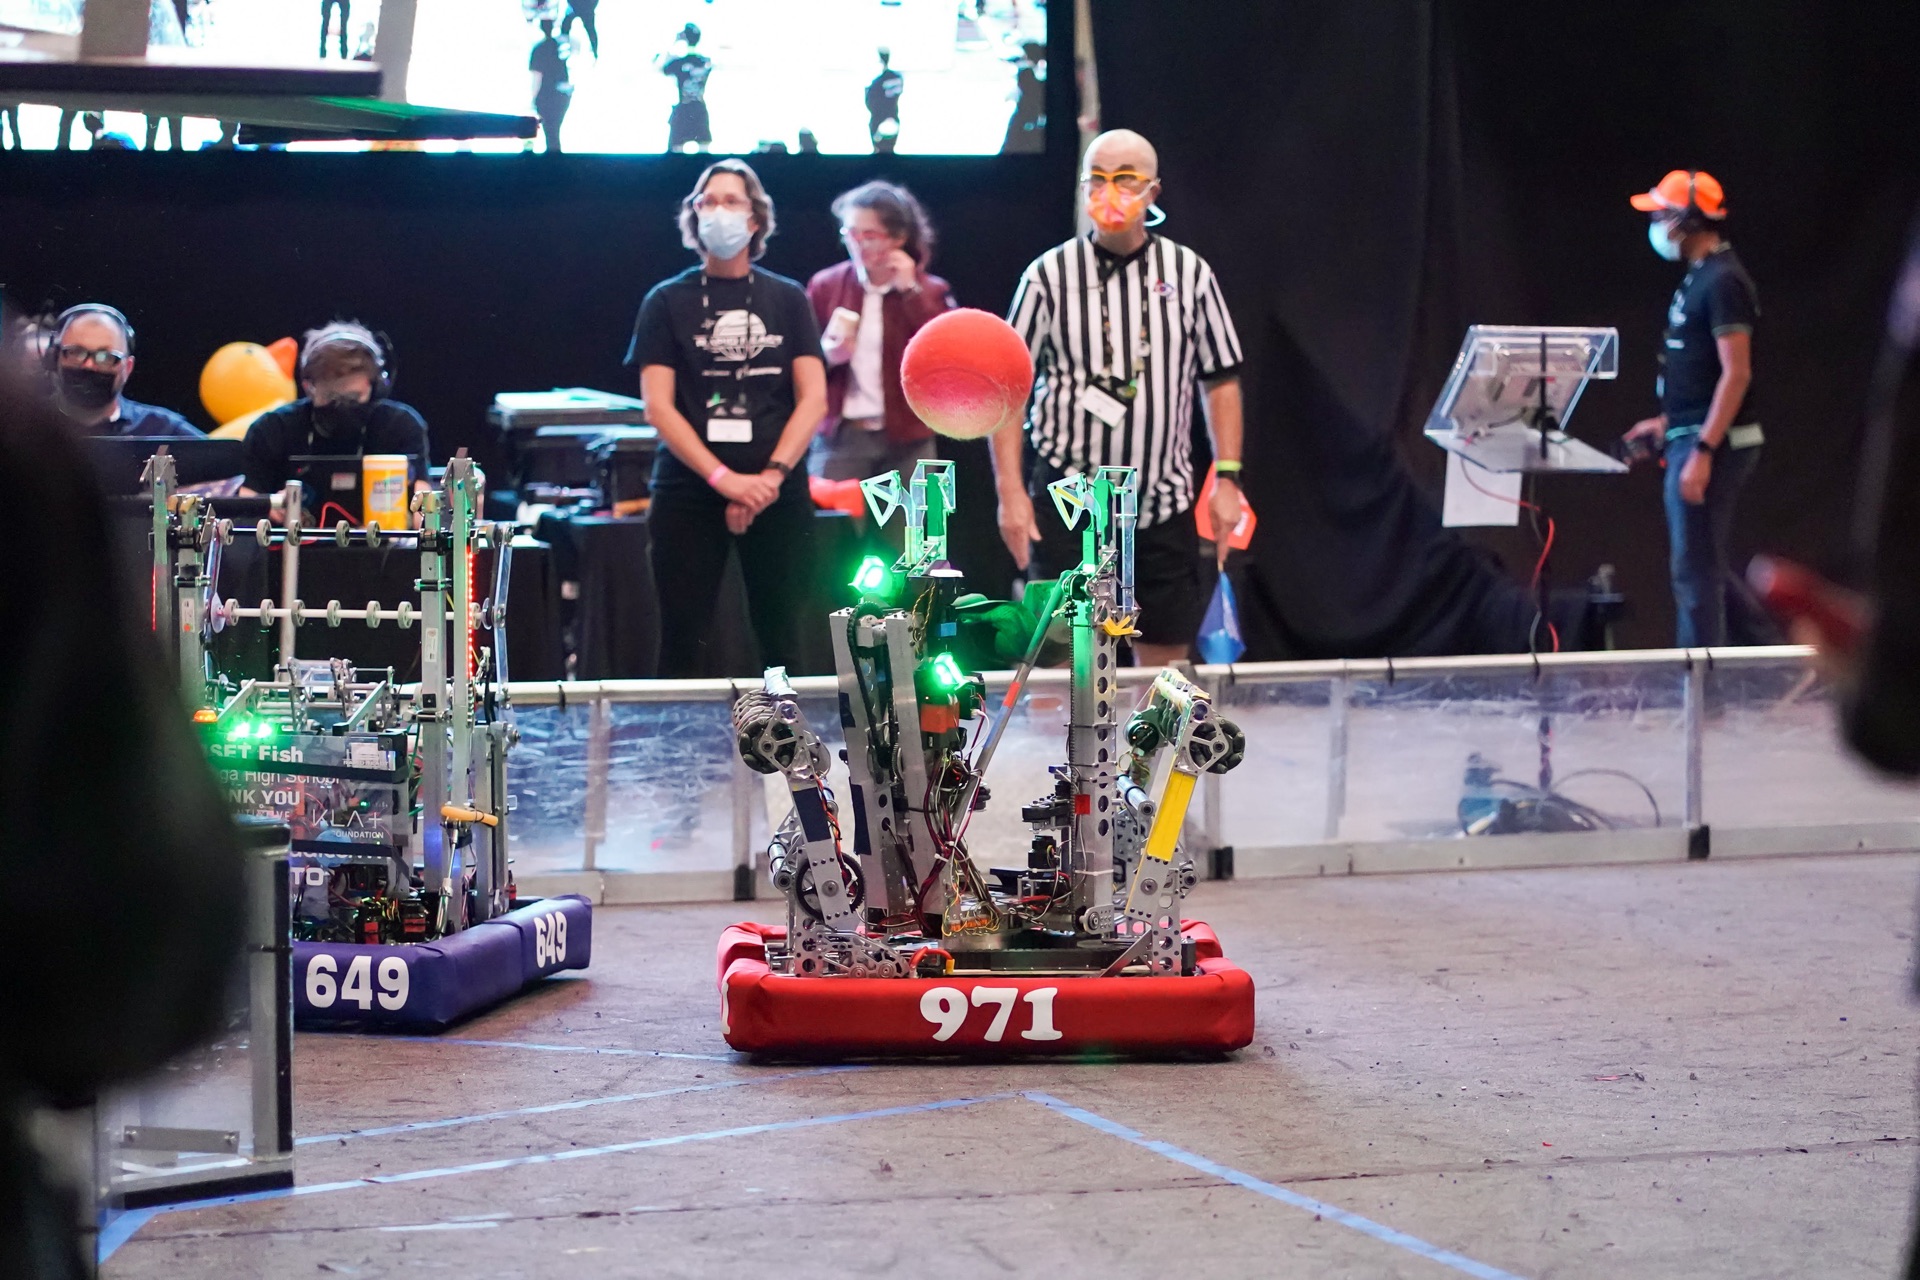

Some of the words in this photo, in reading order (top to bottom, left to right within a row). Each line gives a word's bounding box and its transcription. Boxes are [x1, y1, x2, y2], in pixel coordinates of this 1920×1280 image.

[205, 743, 252, 760] SET
[259, 745, 304, 763] Fish
[244, 770, 281, 786] High
[261, 790, 301, 806] YOU
[333, 830, 384, 840] OUNDATION
[289, 866, 325, 886] TO
[533, 910, 567, 969] 649
[305, 953, 410, 1011] 649
[919, 985, 1063, 1042] 971
